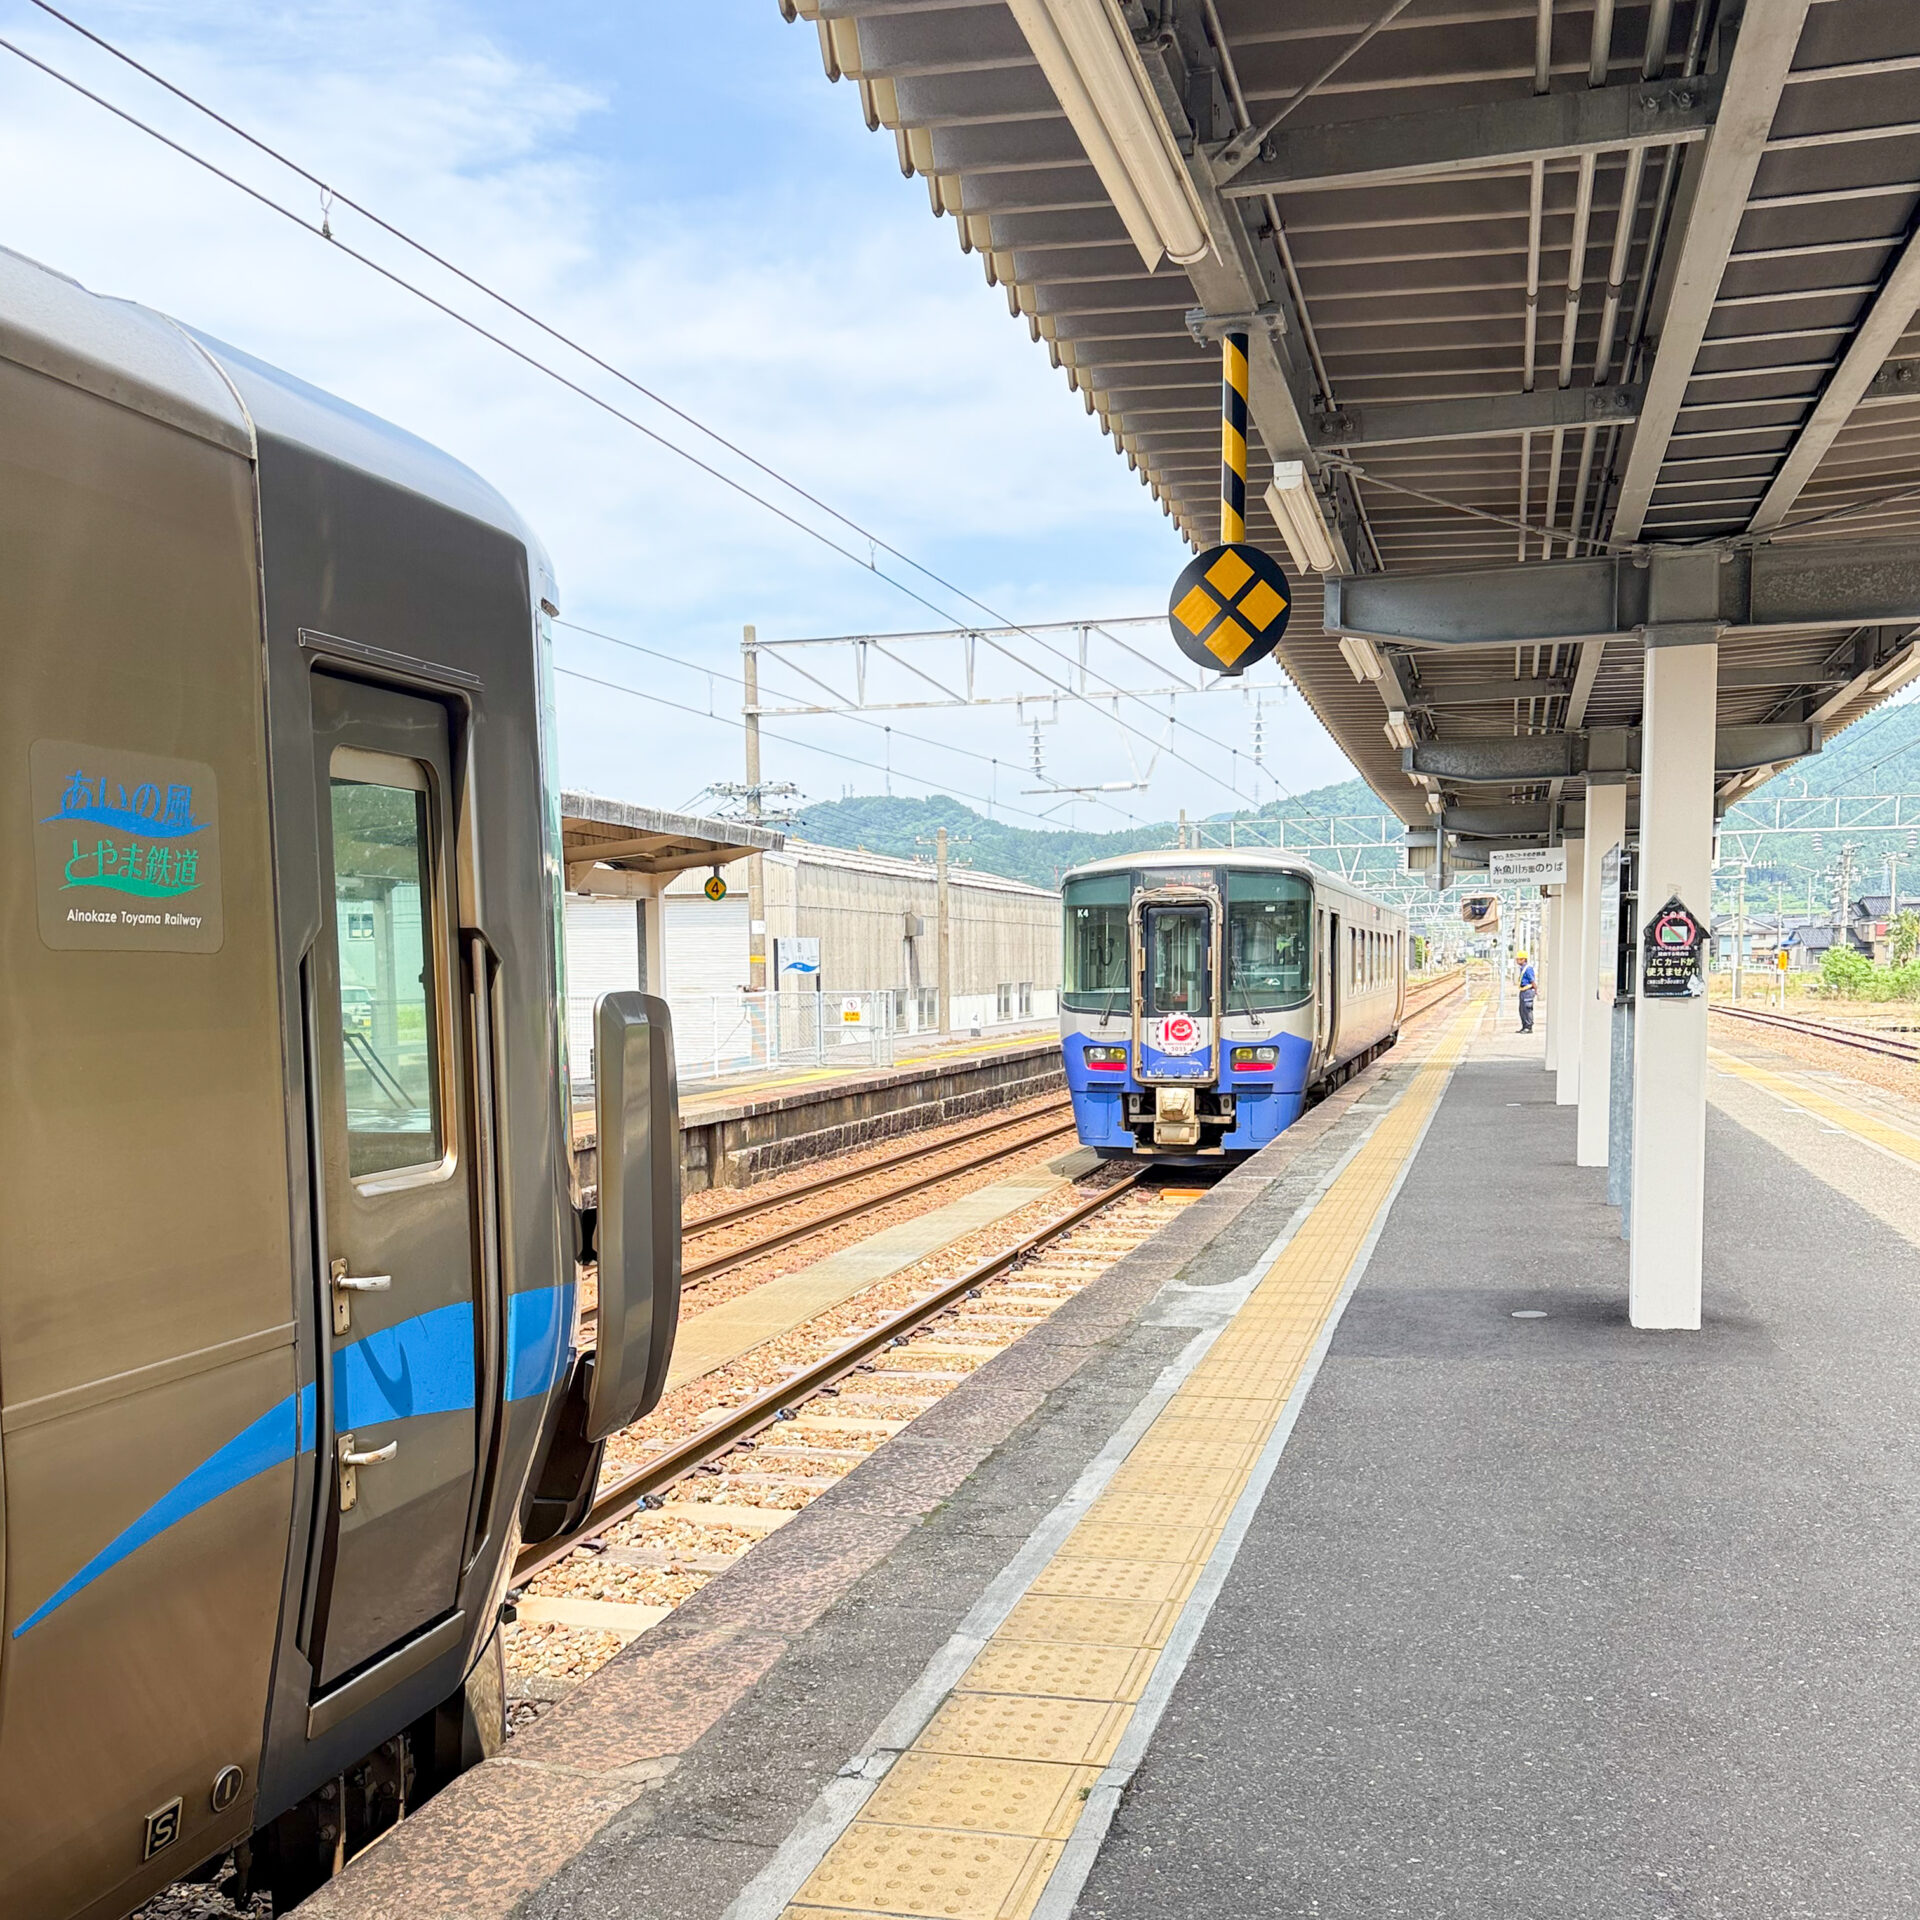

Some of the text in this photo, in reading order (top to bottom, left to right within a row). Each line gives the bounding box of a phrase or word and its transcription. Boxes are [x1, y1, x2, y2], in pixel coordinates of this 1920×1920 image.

[61, 770, 197, 828] あいの風
[64, 840, 200, 886] とやま鉄道
[1493, 862, 1564, 875] 糸魚川方面のりば
[711, 881, 720, 895] 4
[67, 909, 202, 928] Ainokaze Toyama Railway
[1077, 908, 1089, 918] K4
[153, 1813, 174, 1847] S
